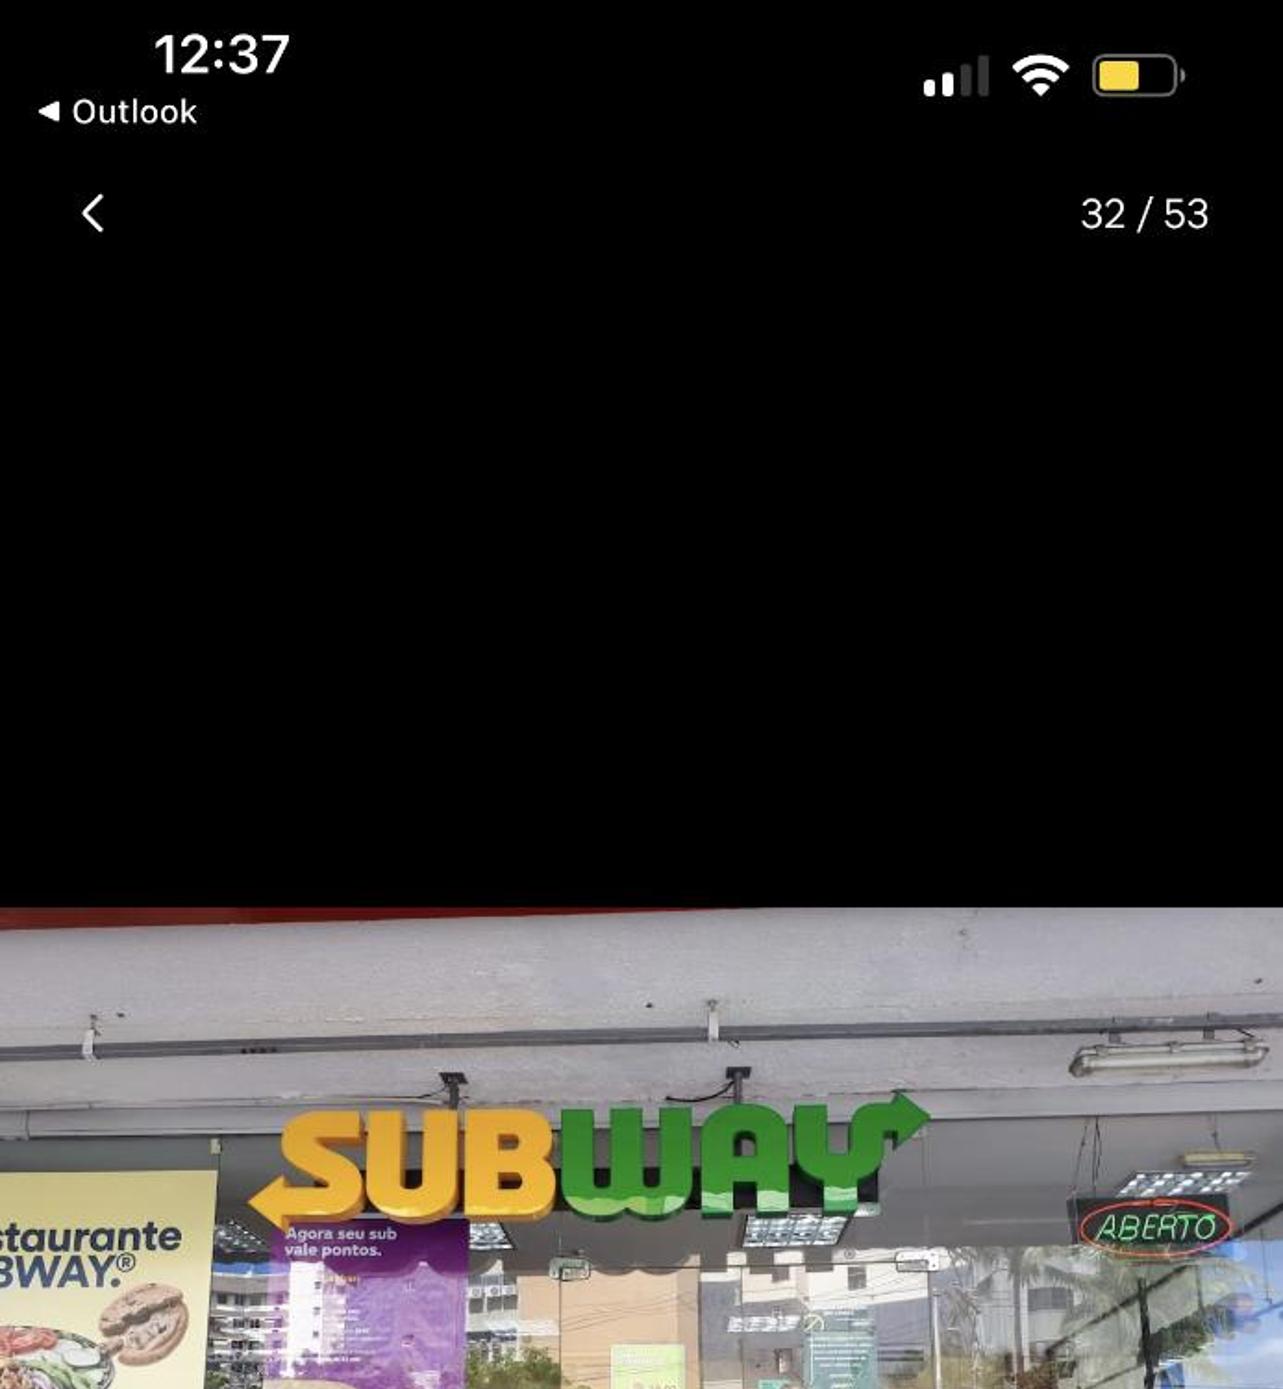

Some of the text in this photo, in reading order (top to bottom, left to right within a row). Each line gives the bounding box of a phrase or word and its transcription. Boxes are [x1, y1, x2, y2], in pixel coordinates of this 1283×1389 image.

[248, 1090, 930, 1230] SUBWAY
[0, 1222, 182, 1252] taurante
[285, 1227, 397, 1241] Agora seu sub
[1095, 1212, 1216, 1241] ABERTO
[284, 1243, 382, 1259] vale pontos.
